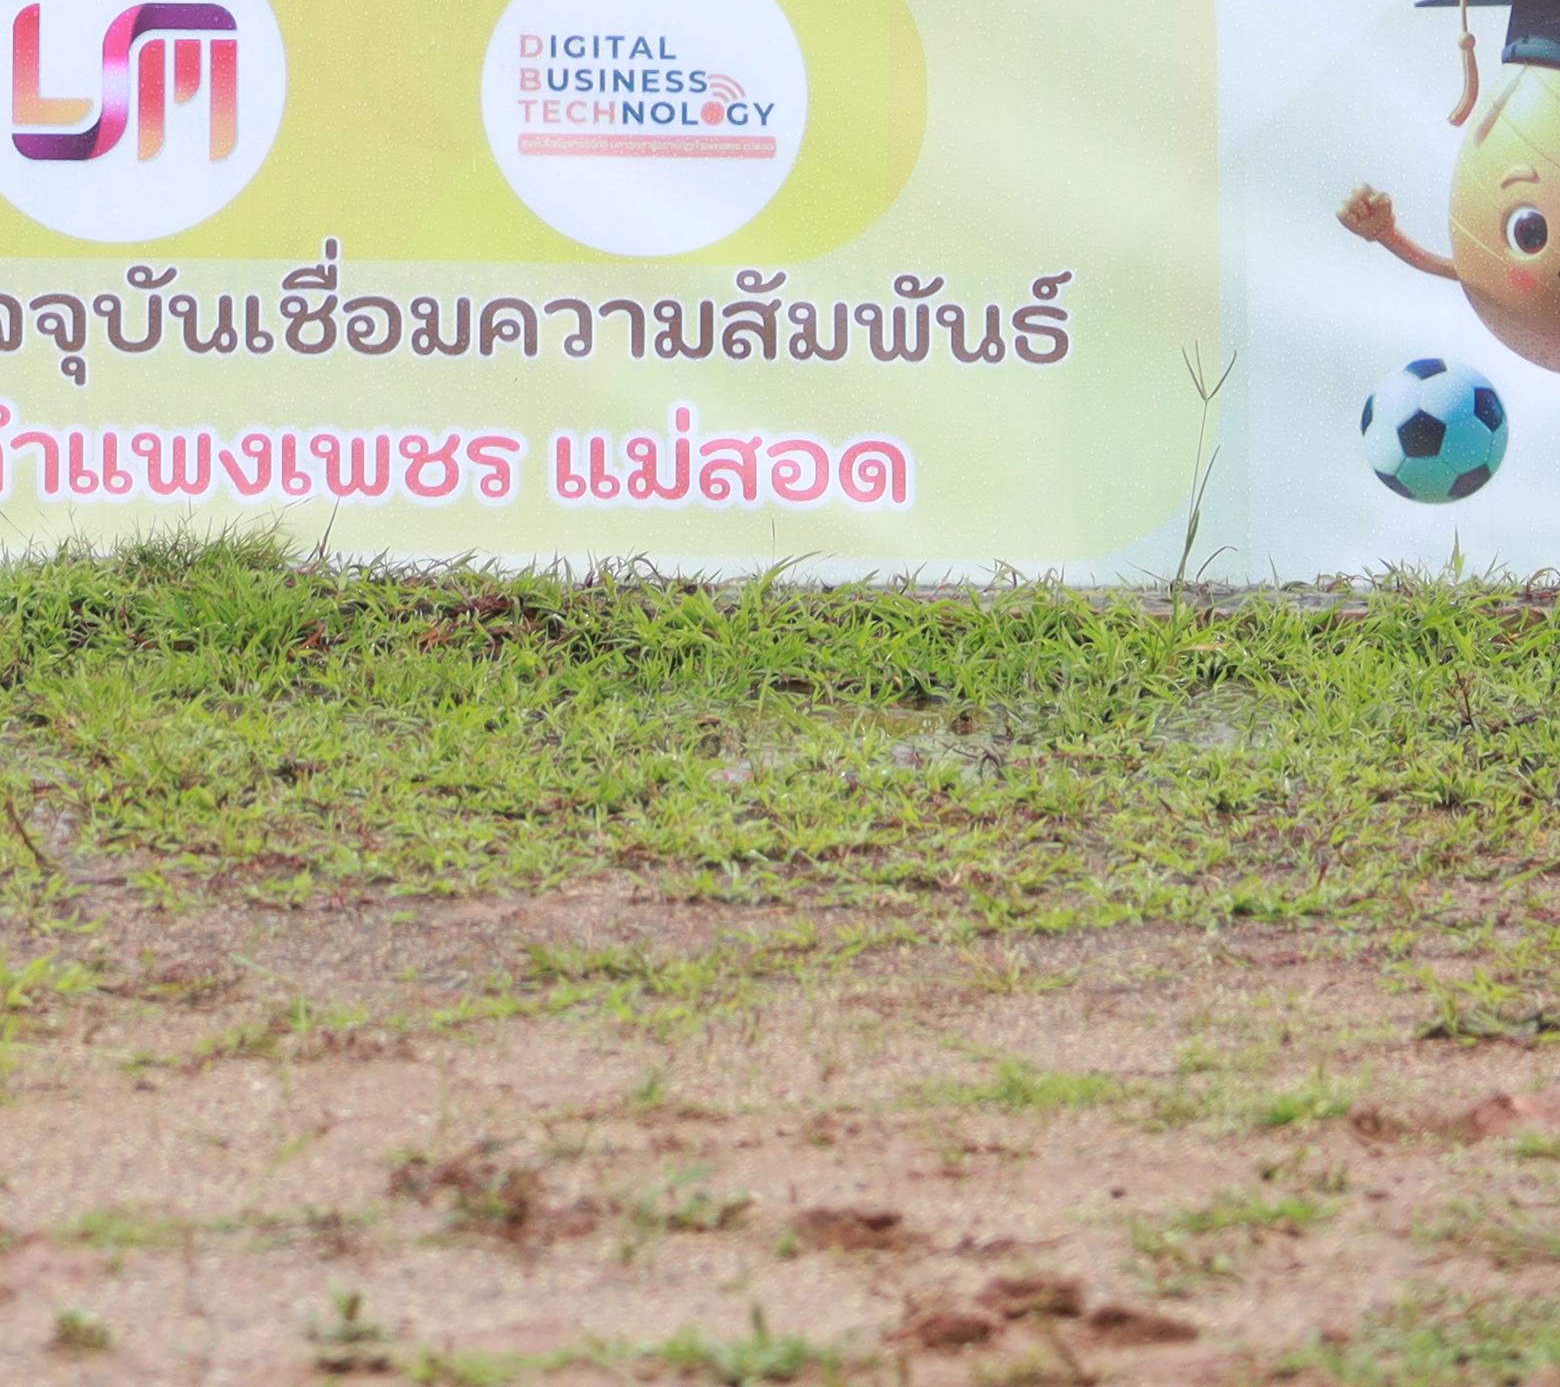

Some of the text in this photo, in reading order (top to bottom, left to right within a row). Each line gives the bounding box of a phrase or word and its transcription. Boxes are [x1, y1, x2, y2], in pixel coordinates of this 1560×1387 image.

[519, 34, 677, 60] DIGITAL
[519, 68, 708, 93] BUSINESS
[557, 407, 909, 504] แม่สอด
